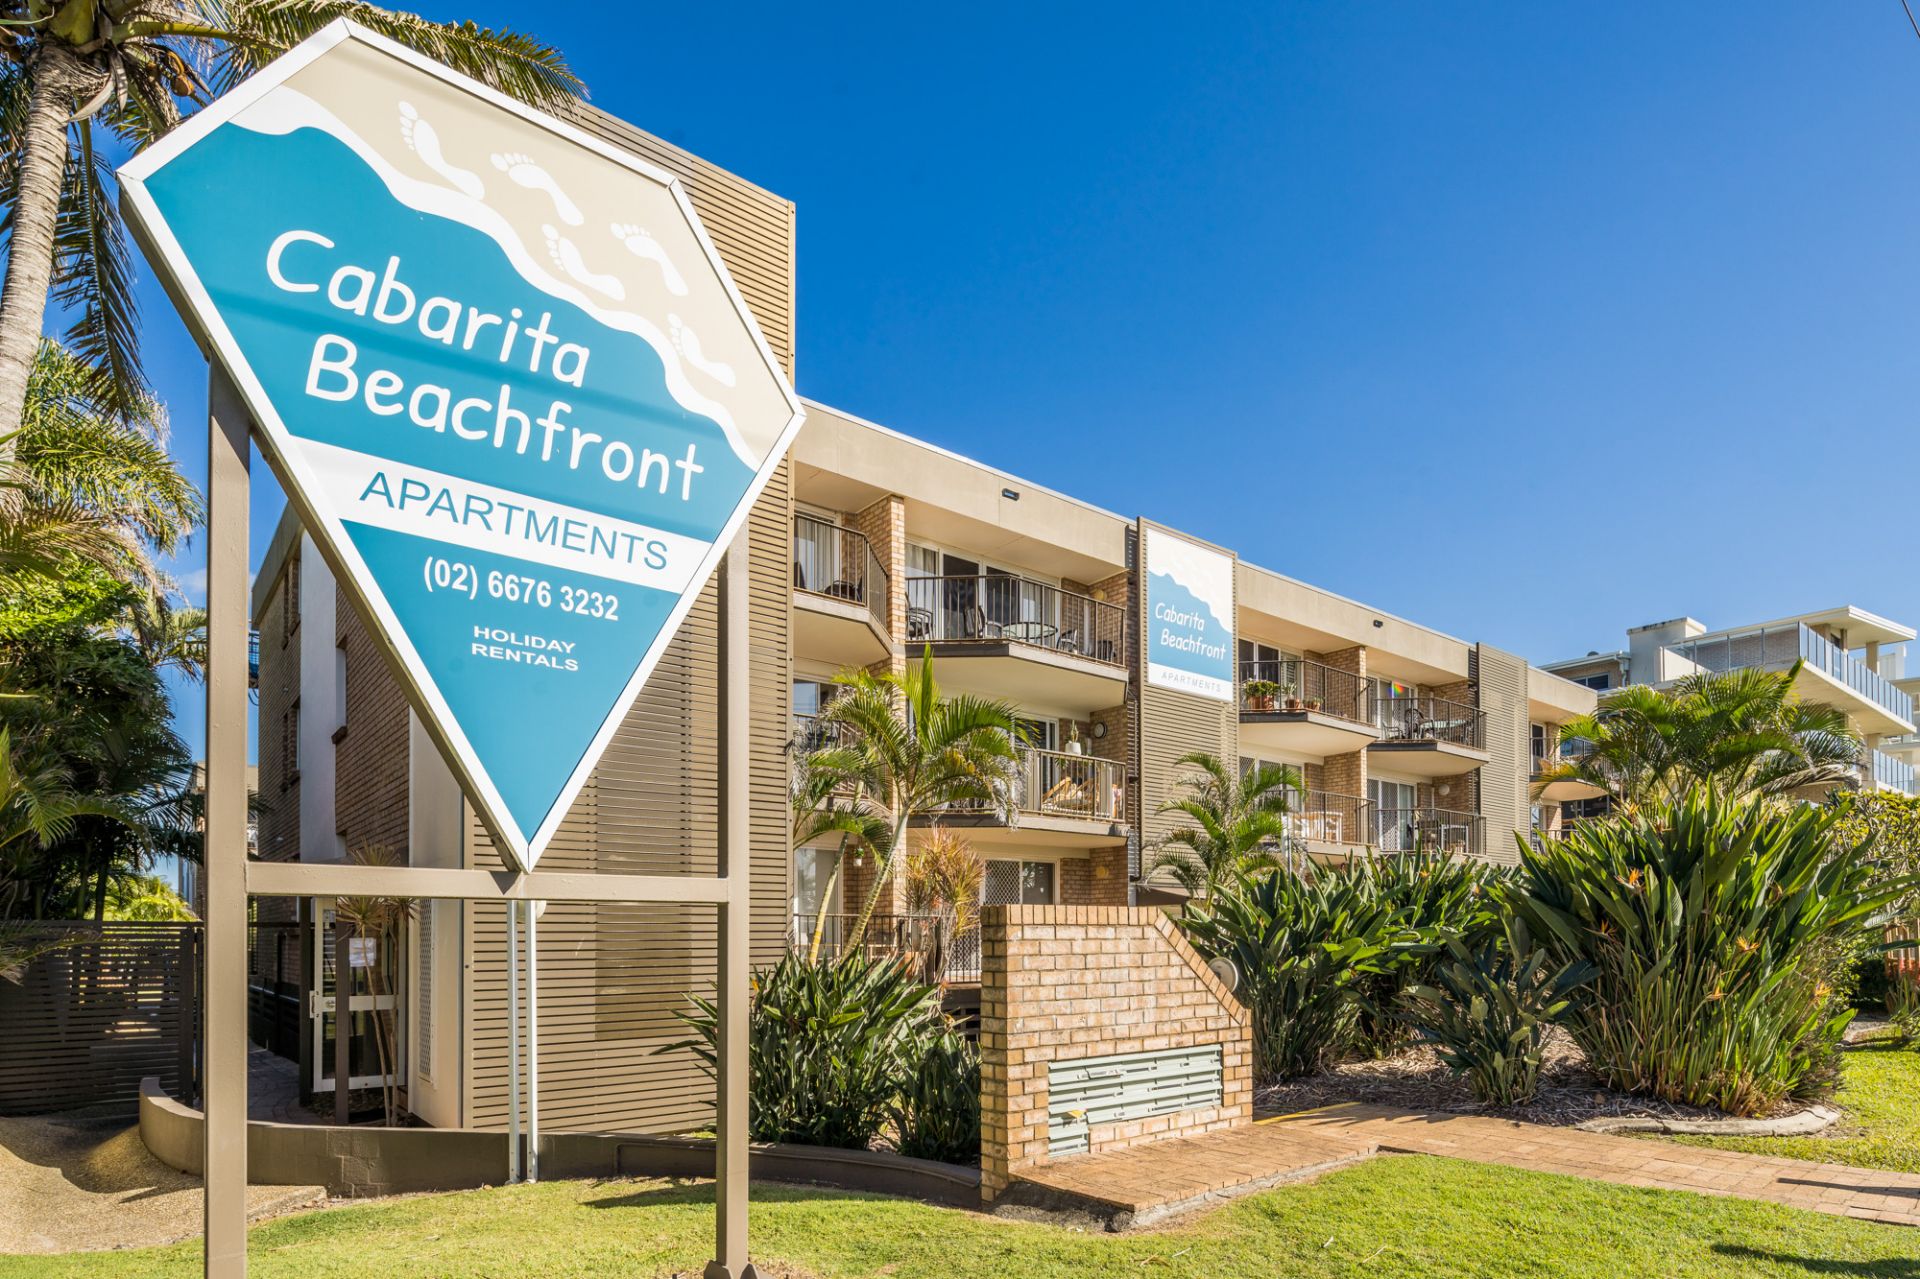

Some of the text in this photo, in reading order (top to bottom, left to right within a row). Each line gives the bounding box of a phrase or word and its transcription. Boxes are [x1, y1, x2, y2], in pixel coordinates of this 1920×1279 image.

[265, 229, 590, 388] Cabarita
[304, 334, 704, 501] Beachfront
[359, 471, 669, 571] APARTMENTS
[423, 556, 619, 621] (02) 6676 3232
[1155, 602, 1205, 631] Cabarita
[473, 626, 576, 654] HOLIDAY
[1160, 628, 1226, 661] Beachfront
[471, 643, 580, 672] RENTALS
[1161, 671, 1222, 692] APARTMENTS
